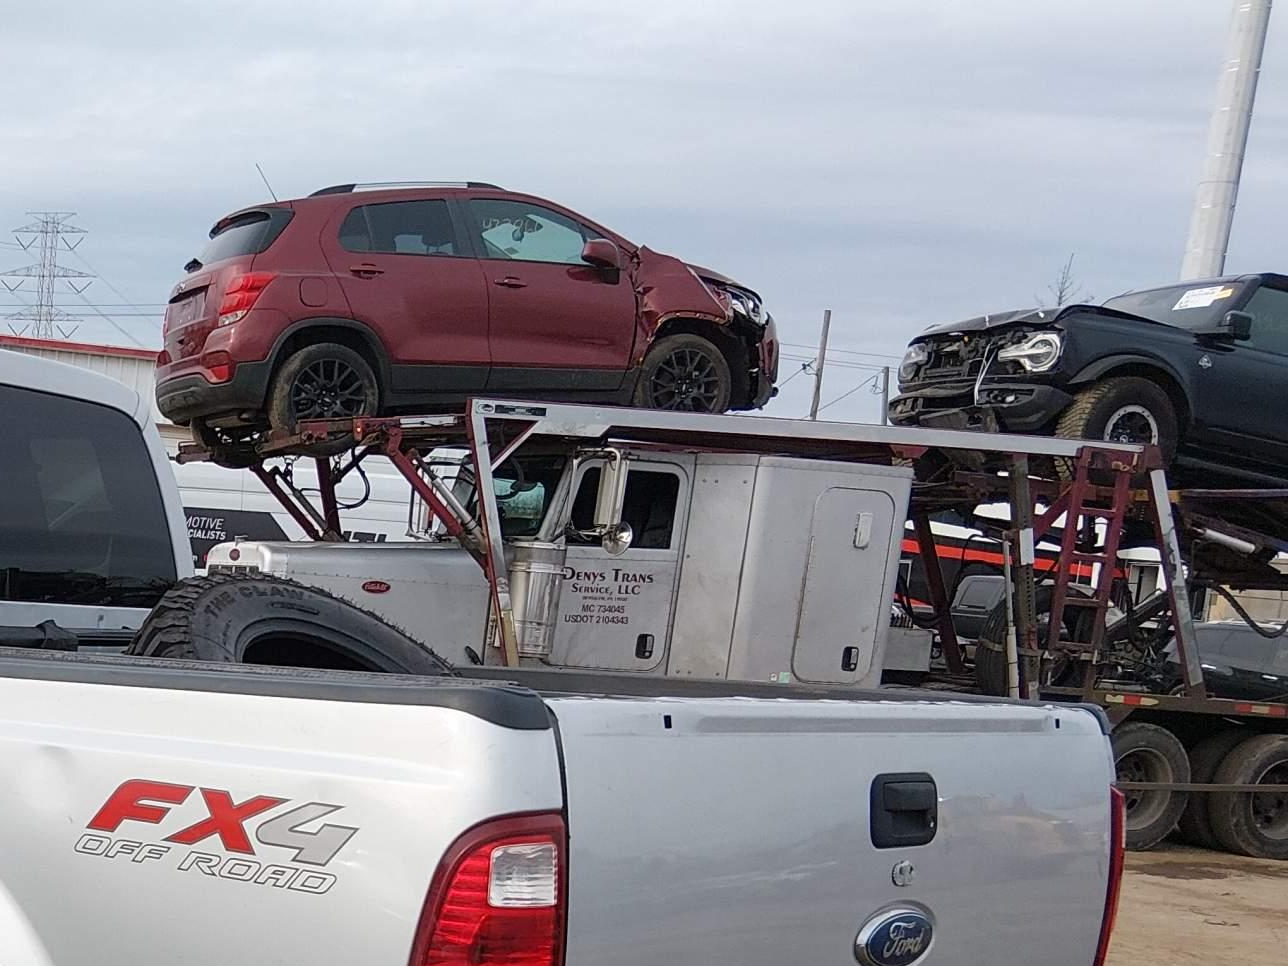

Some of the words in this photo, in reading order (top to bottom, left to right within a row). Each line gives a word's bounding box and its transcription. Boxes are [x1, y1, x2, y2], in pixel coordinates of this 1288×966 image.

[612, 568, 655, 584] TRANS
[617, 584, 641, 596] LLC
[581, 604, 596, 614] MC
[597, 604, 626, 614] 734045
[564, 614, 594, 624] USDOT
[595, 615, 630, 625] 2104343
[86, 778, 360, 867] FX4
[74, 832, 171, 864] OFF
[177, 850, 338, 895] ROAD
[882, 921, 925, 959] Ford
